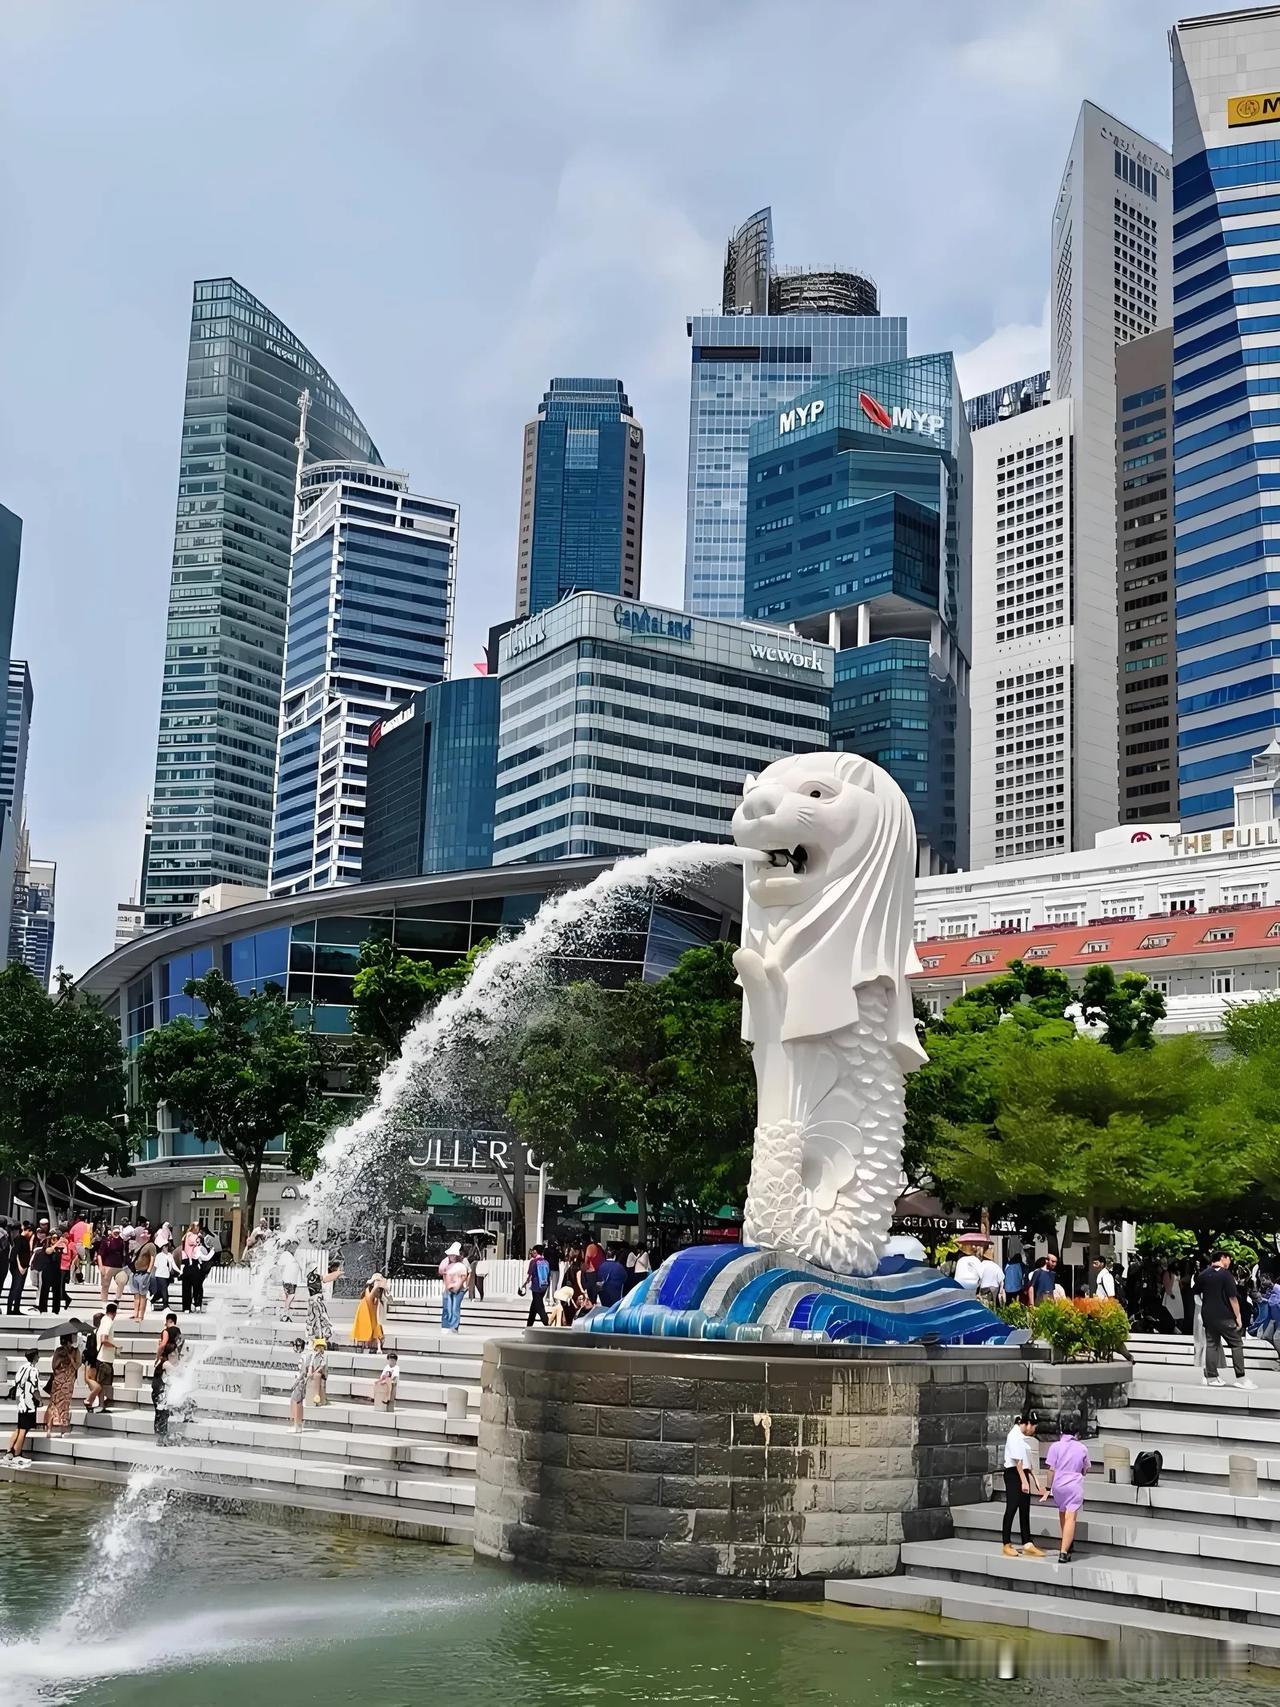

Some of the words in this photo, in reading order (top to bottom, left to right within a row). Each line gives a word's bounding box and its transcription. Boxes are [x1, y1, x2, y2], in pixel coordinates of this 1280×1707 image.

[779, 400, 824, 435] MYP
[892, 406, 945, 436] MYP
[613, 603, 691, 640] CapitaLand
[749, 643, 824, 672] wework
[1168, 833, 1212, 856] THE
